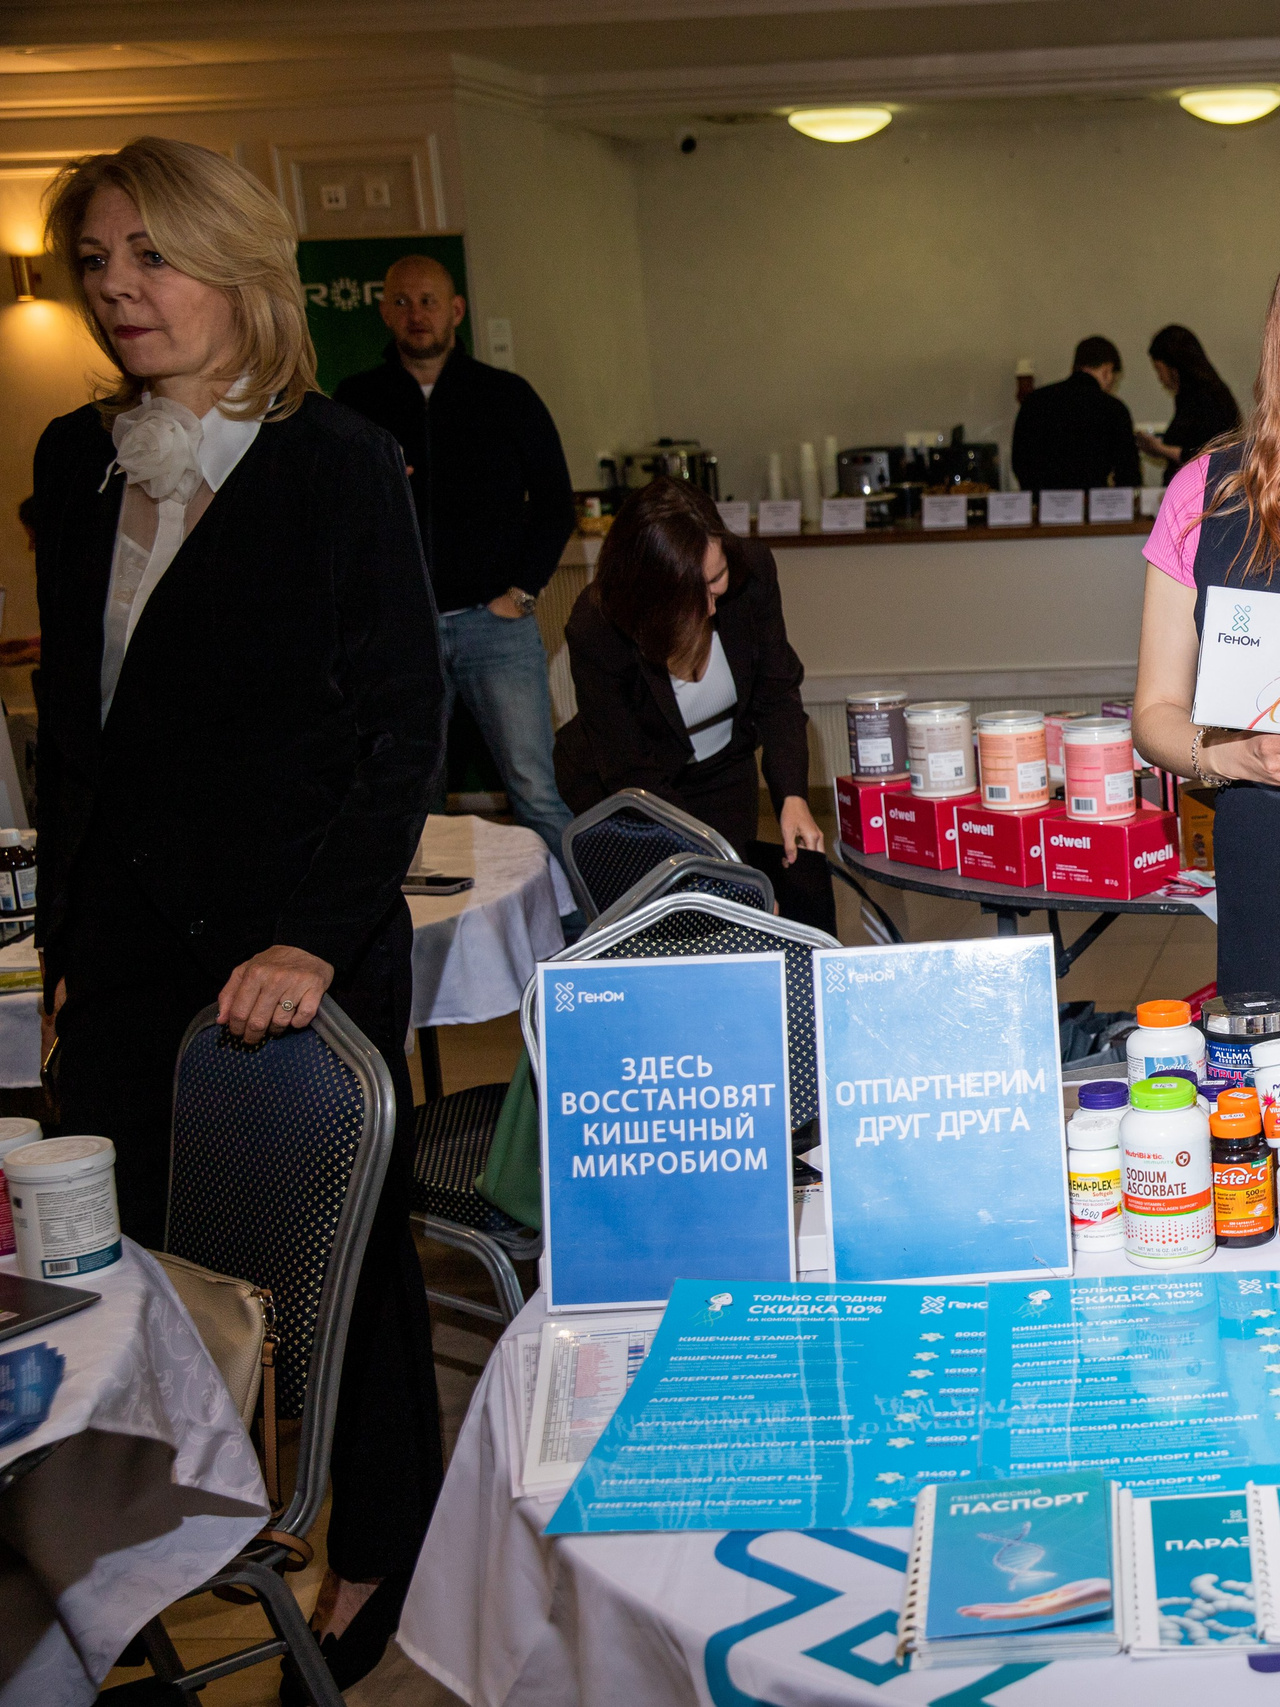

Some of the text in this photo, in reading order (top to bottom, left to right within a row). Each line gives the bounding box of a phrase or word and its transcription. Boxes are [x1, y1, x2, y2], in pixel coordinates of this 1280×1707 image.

[1218, 632, 1260, 647] ГенОм
[962, 821, 994, 837] o!well
[1050, 834, 1091, 849] o!well
[1134, 844, 1174, 869] o!well
[578, 990, 624, 1003] ГенОм
[1215, 1051, 1251, 1060] ALLMA
[621, 1055, 713, 1085] ЗДЕСЬ
[835, 1068, 1046, 1107] ОТПАРТНЕРИМ
[561, 1083, 776, 1115] ВОССТАНОВЯТ
[583, 1112, 754, 1146] КИШЕЧНЫЙ
[855, 1106, 1031, 1147] ДРУГ ДРУГА
[572, 1147, 768, 1178] МИКРОБИОМ
[1126, 1167, 1167, 1183] SODIUM
[1213, 1167, 1267, 1186] Ester-C
[1127, 1182, 1187, 1197] ASCORBATE
[1070, 1282, 1203, 1295] ТОЛЬКО СЕГОДНЯ!
[753, 1294, 887, 1303] ТОЛЬКО СЕГОДНЯ!
[1070, 1289, 1204, 1304] СКИДКА 10%
[749, 1304, 883, 1315] СКИДКА 10%
[1012, 1321, 1084, 1332] КИШЕЧНИК
[753, 1334, 819, 1342] STANDART
[1012, 1339, 1085, 1350] КИШЕЧНИК
[669, 1354, 743, 1362] КИШЕЧНИК
[659, 1372, 800, 1383] АЛЛЕРГИЯ STANDART
[649, 1395, 720, 1403] АЛЛЕРГИЯ
[1120, 1419, 1187, 1430] ПАСПОРТ
[1189, 1413, 1260, 1425] STANDART
[1123, 1453, 1192, 1464] ПАСПОРТ
[1193, 1449, 1230, 1459] PLUS
[786, 1474, 823, 1482] PLUS
[1125, 1474, 1221, 1488] ПАСПОРТ VIP
[951, 1488, 1041, 1501] ГЕНЕТИЧЕСКИЙ
[950, 1492, 1089, 1516] ПАСПОРТ
[1165, 1536, 1250, 1551] ПАРАЗ
